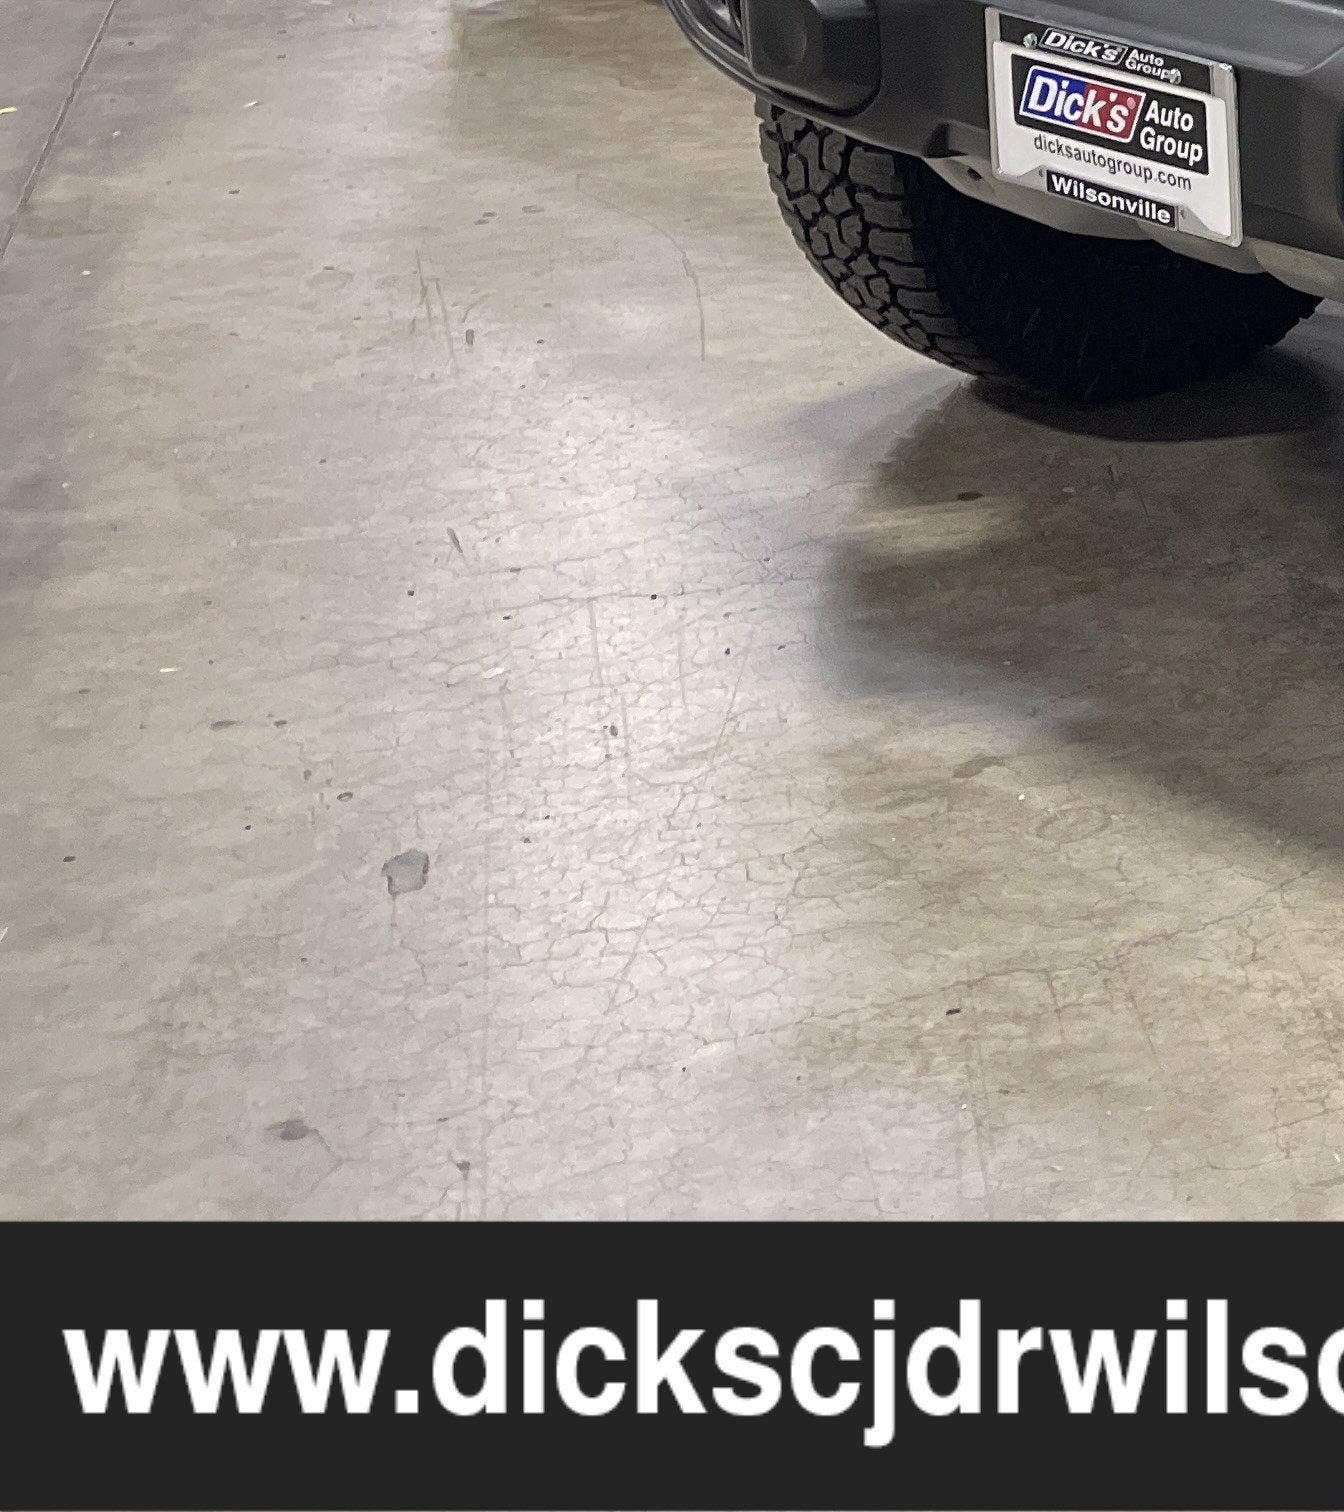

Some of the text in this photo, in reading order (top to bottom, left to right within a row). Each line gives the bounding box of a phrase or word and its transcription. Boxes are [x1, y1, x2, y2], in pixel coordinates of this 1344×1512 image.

[1044, 31, 1119, 61] Dick's
[1127, 49, 1165, 67] Auto
[1028, 74, 1130, 134] Dick's
[1145, 100, 1194, 132] Auto
[1034, 134, 1192, 191] dicksautogroup.com
[1140, 128, 1203, 166] Group
[1051, 174, 1171, 224] Wilsonville
